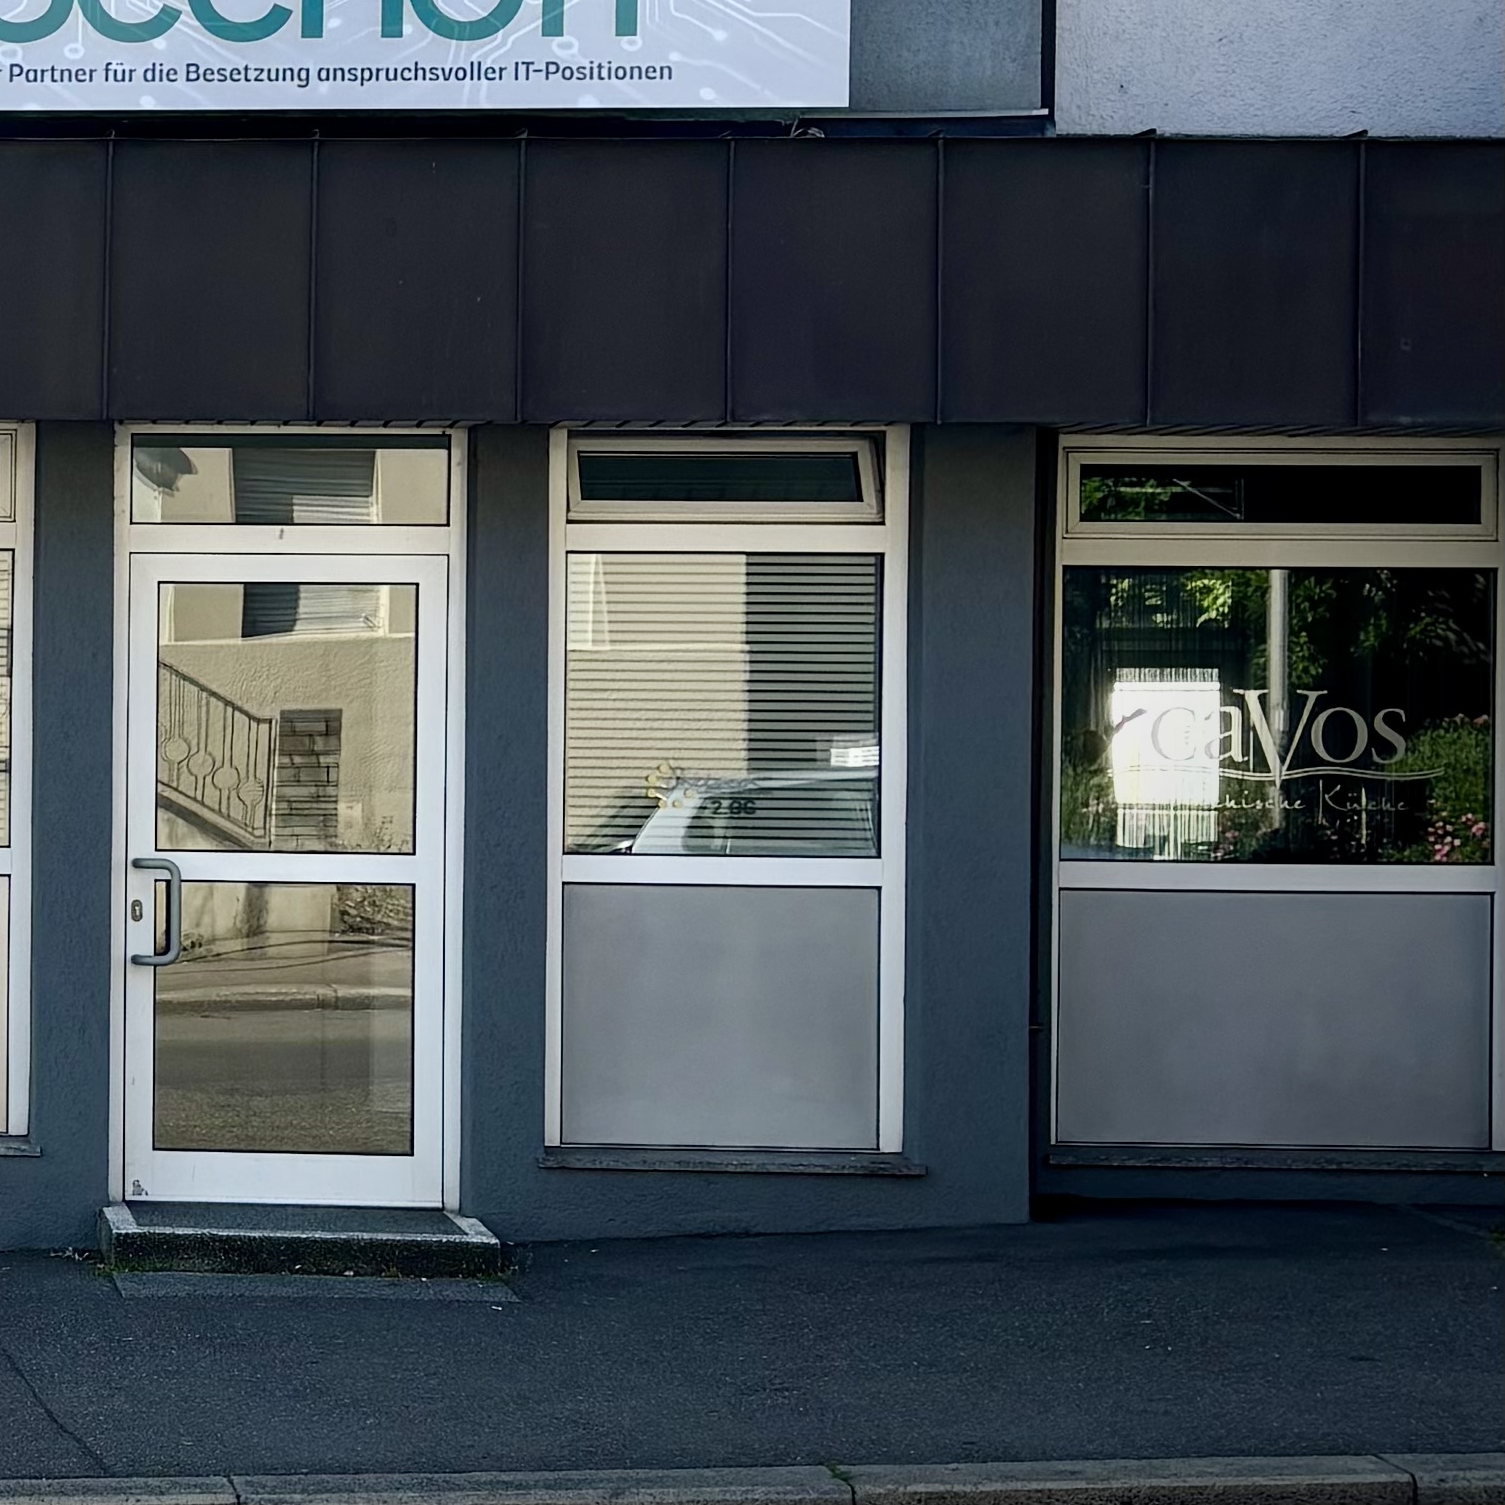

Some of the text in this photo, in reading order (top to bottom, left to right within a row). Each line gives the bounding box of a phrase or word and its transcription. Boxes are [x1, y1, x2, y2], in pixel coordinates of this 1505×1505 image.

[8, 62, 99, 84] Partner
[103, 60, 137, 85] für
[143, 61, 179, 84] die
[184, 61, 311, 90] Besetzung
[316, 59, 509, 88] anspruchsvoller
[513, 59, 674, 83] IT-Positionen
